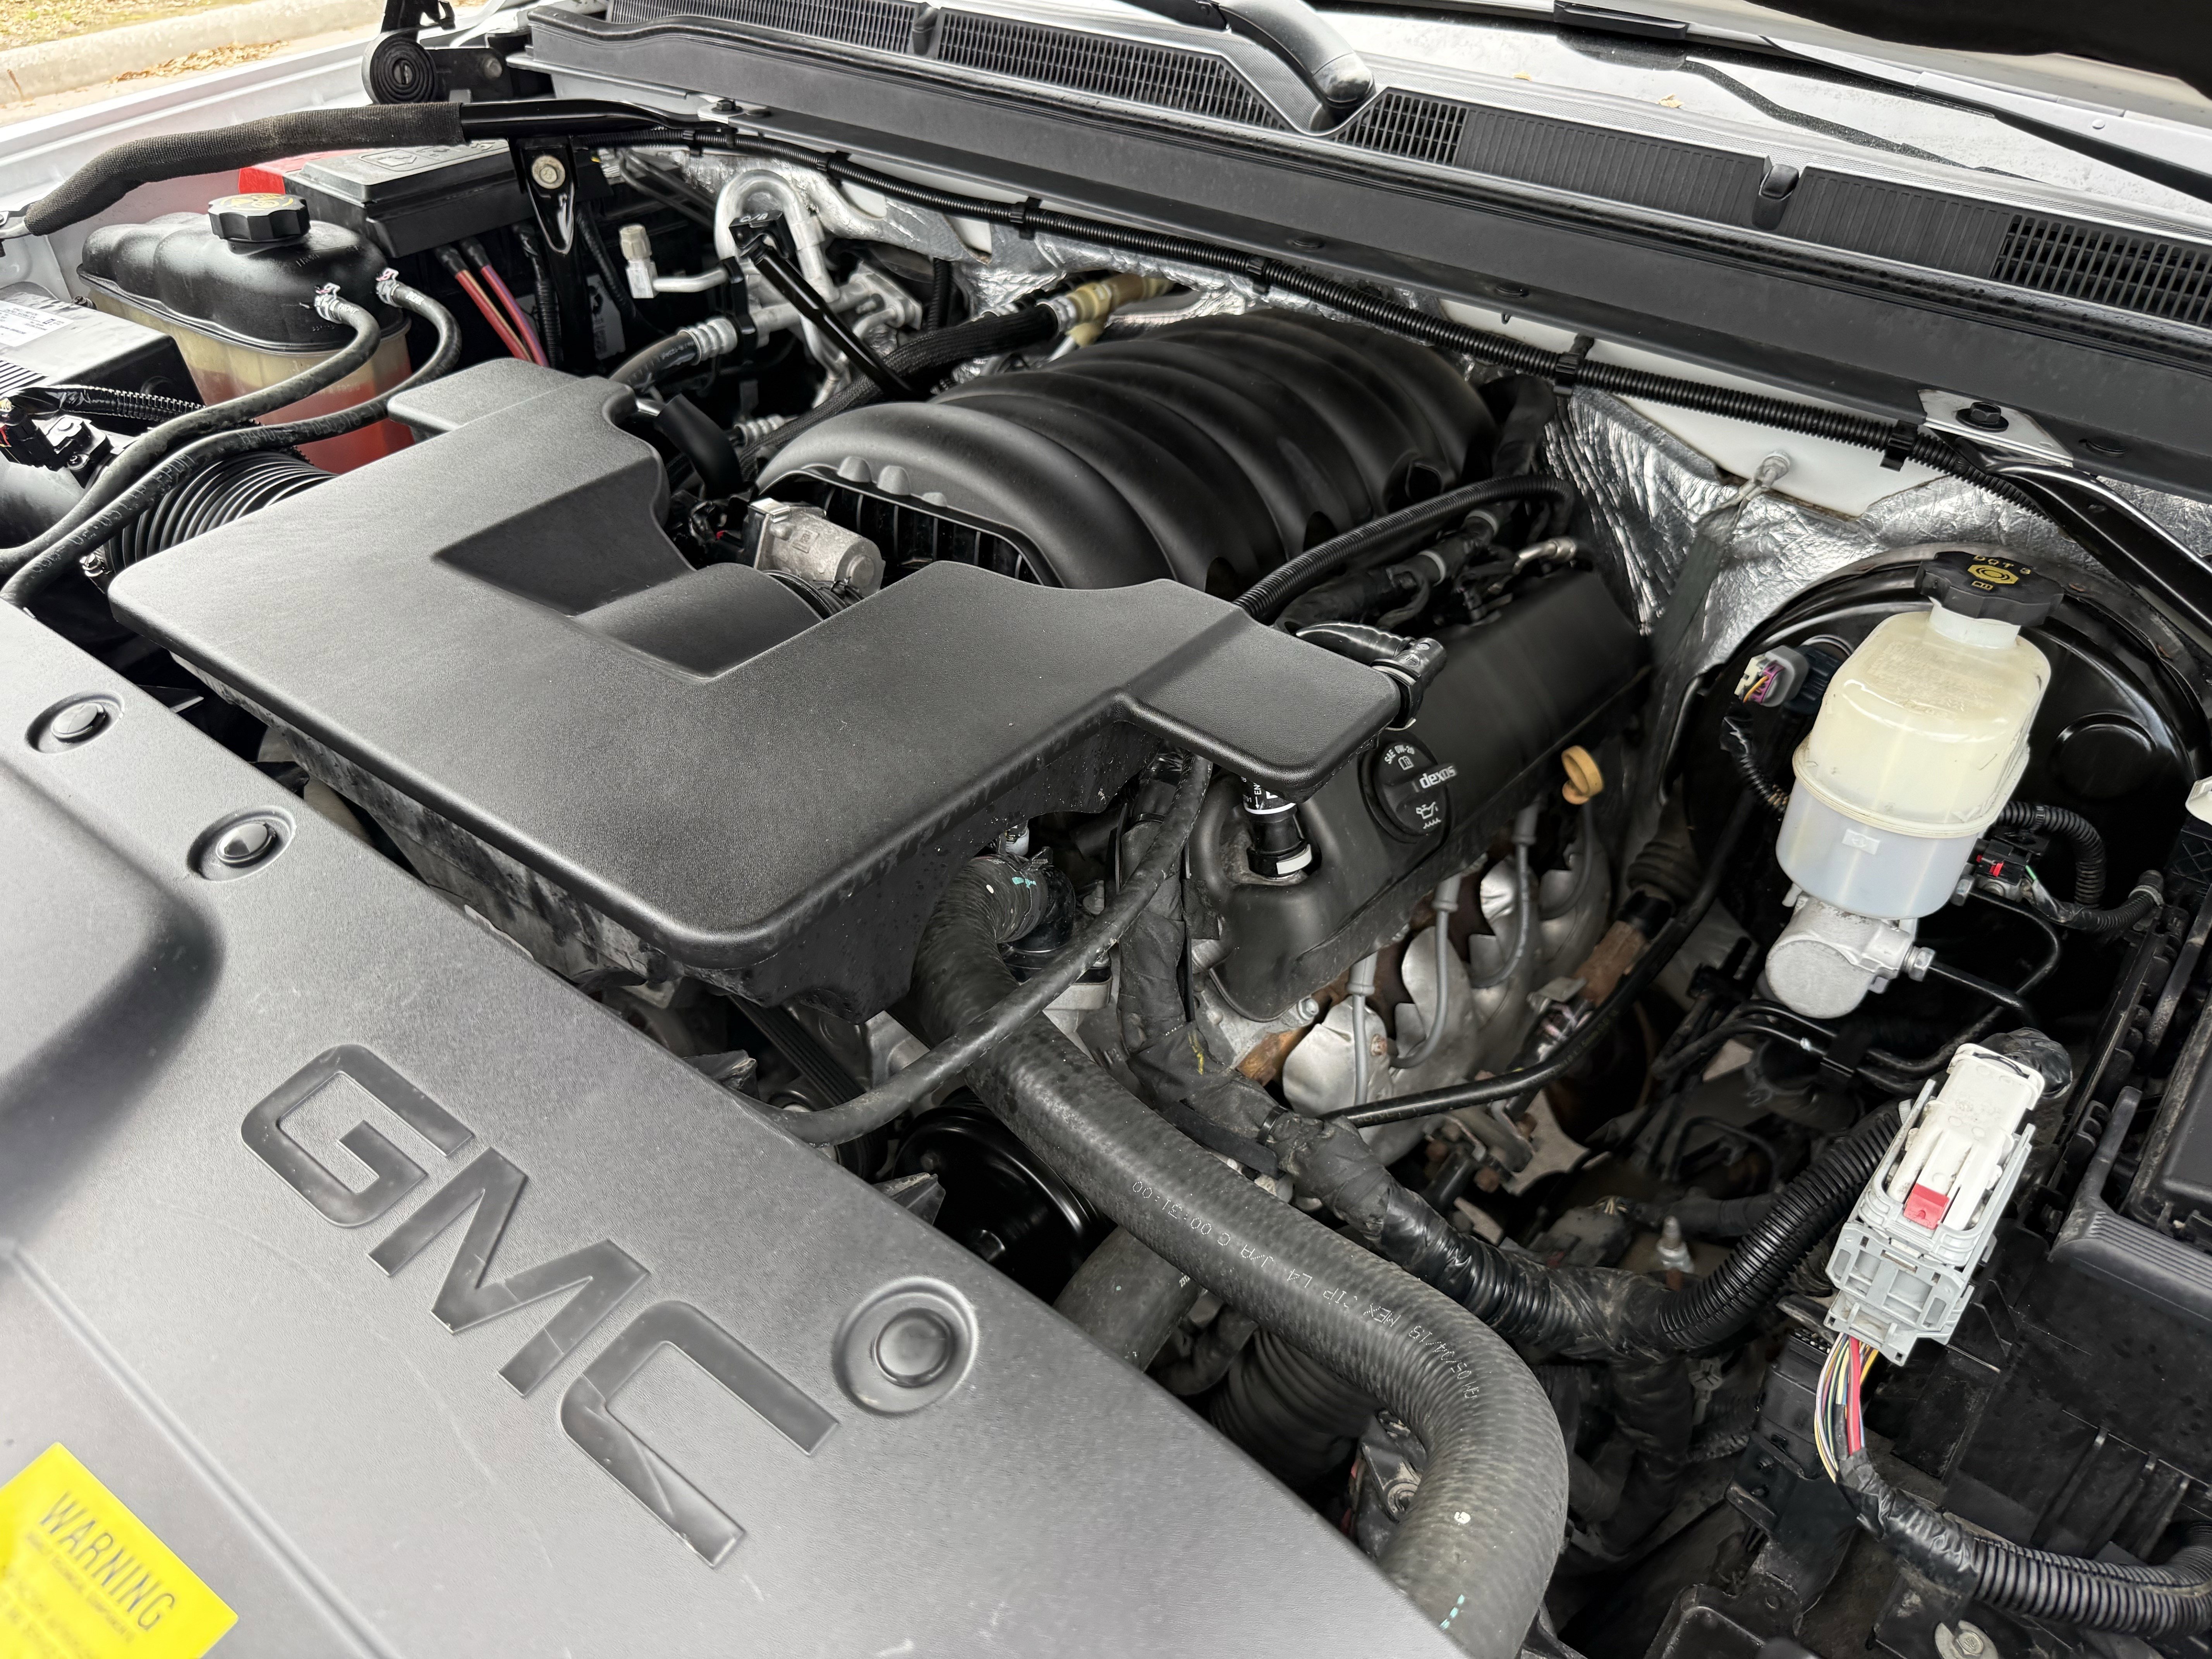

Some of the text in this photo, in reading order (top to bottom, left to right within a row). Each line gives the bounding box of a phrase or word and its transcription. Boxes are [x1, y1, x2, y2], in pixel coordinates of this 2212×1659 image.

[1973, 555, 2014, 568] DOT
[1384, 744, 1415, 764] SAE 0W-20
[1419, 765, 1457, 789] dexos
[1132, 1181, 1212, 1235] 00:31:00
[1287, 1269, 1312, 1288] L4
[241, 1043, 840, 1569] GMC
[1363, 1303, 1401, 1327] MEX
[40, 1491, 175, 1631] WARNING
